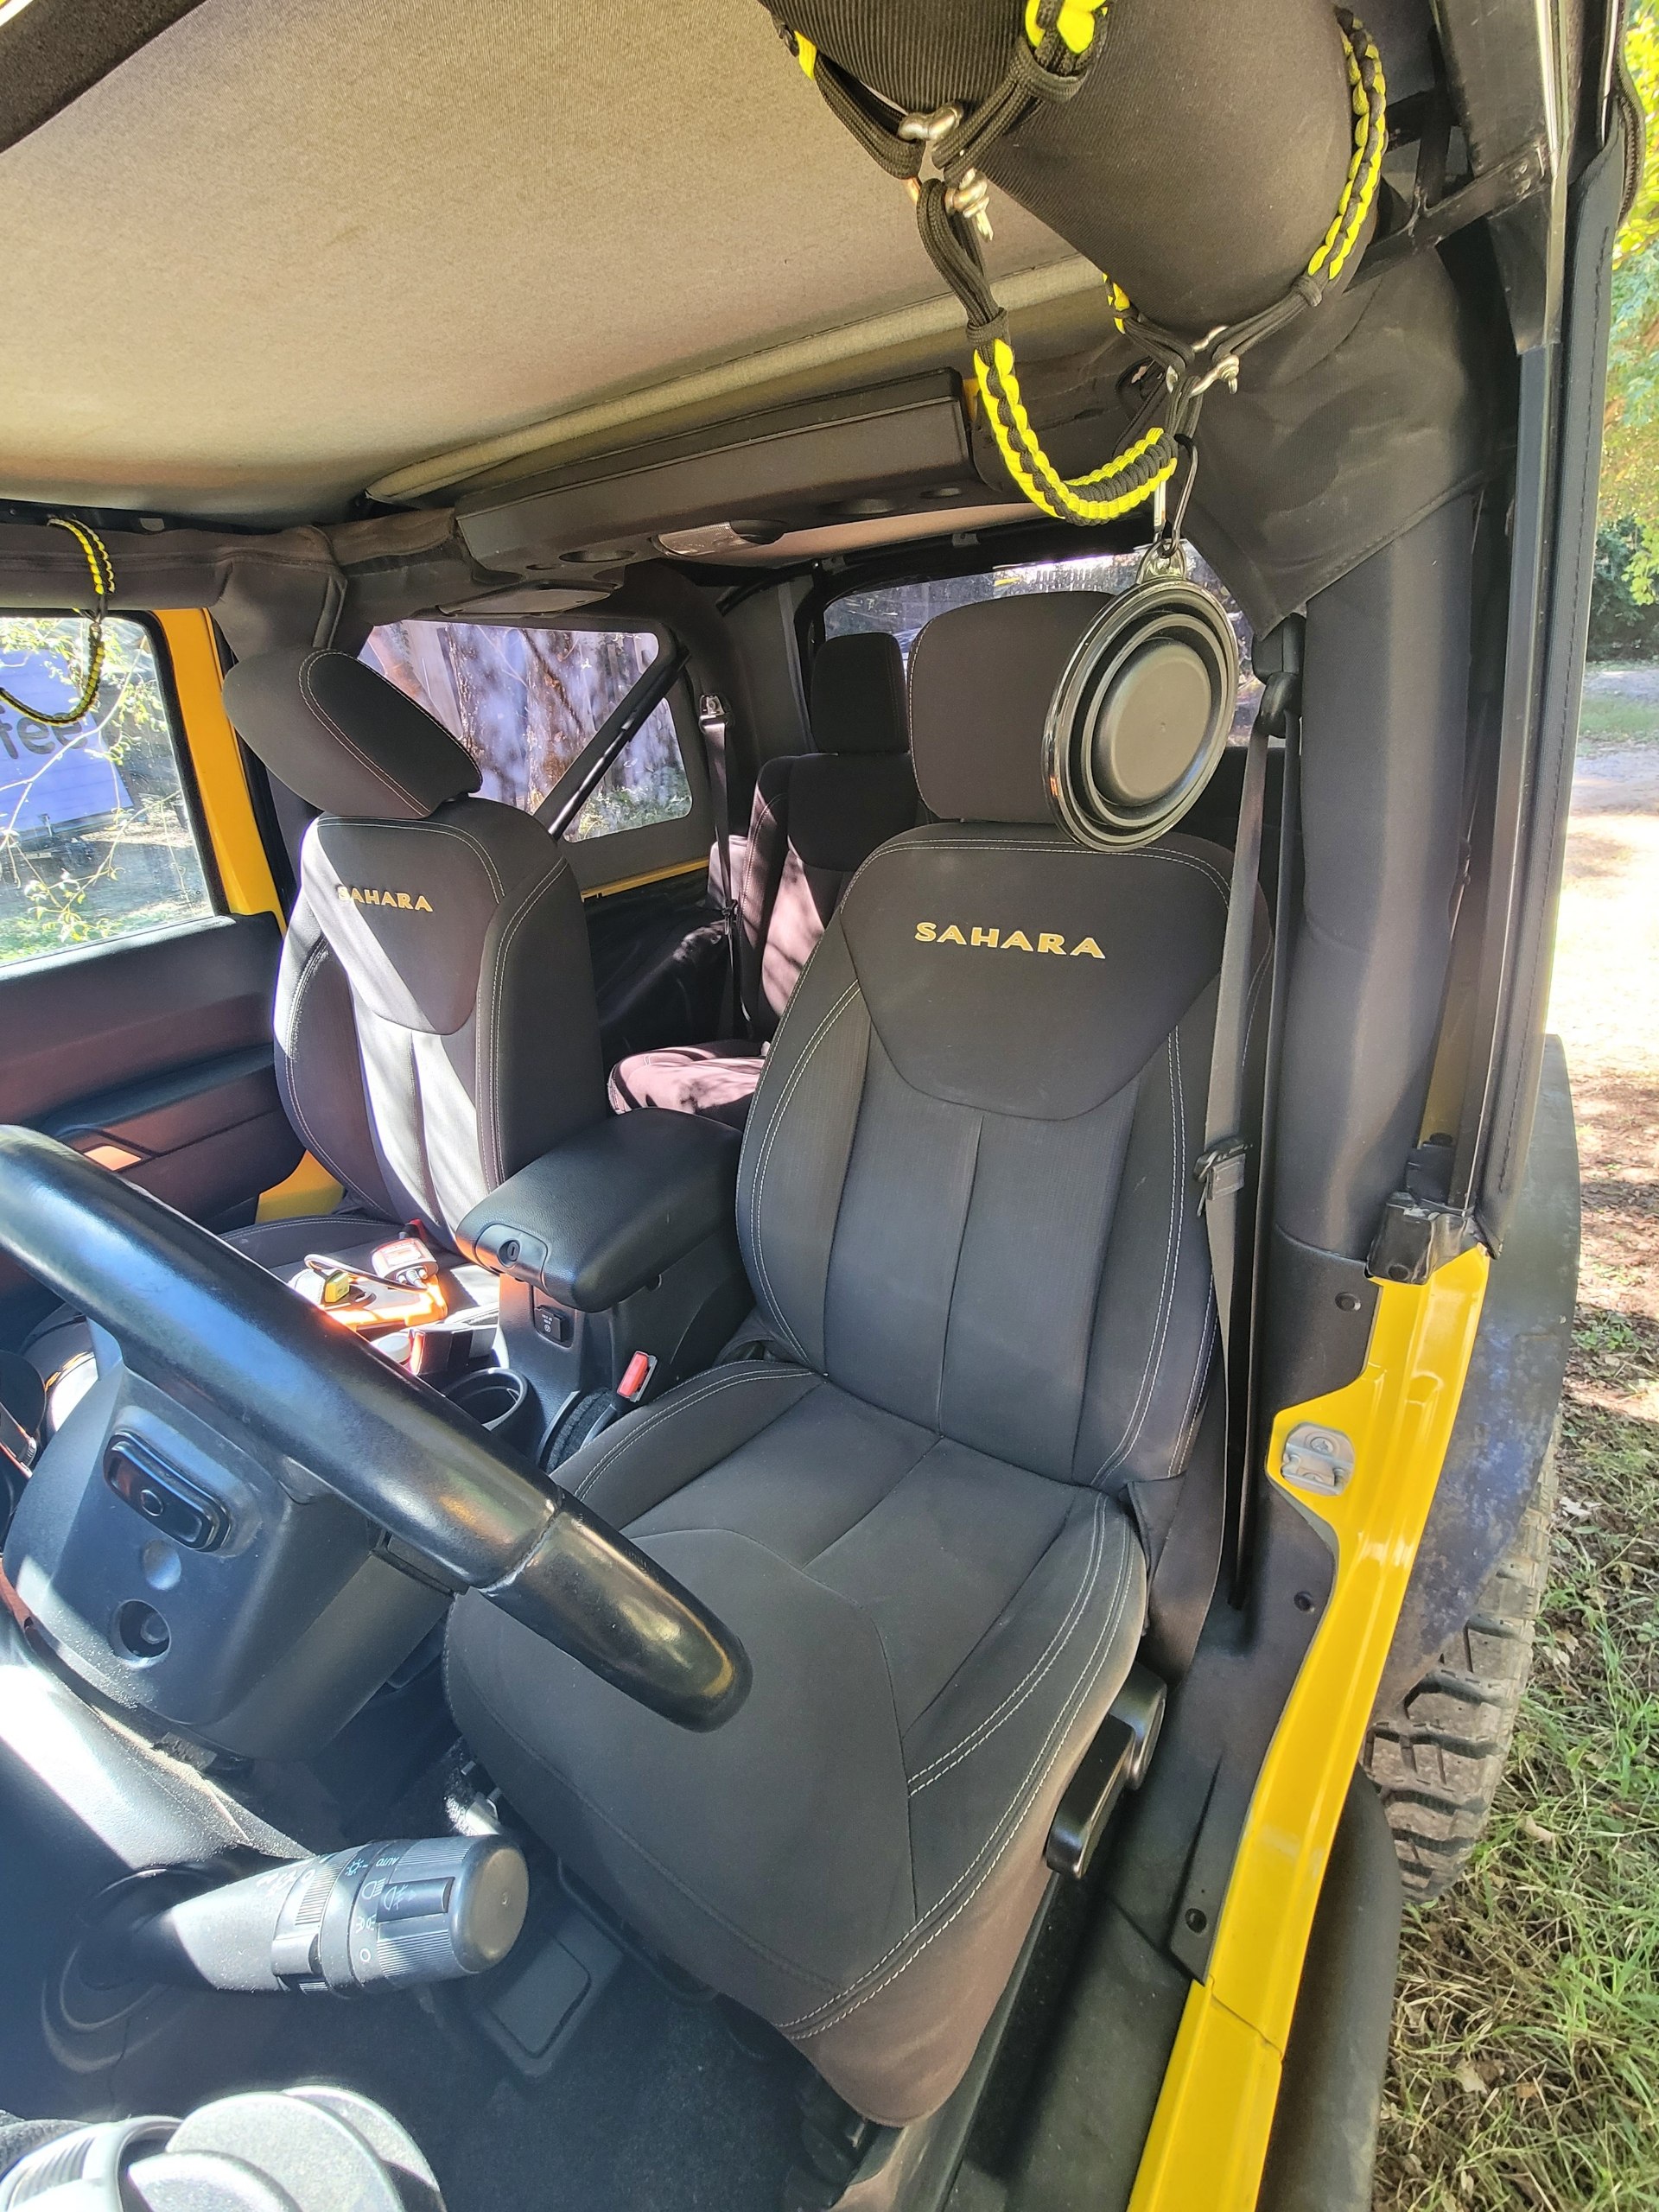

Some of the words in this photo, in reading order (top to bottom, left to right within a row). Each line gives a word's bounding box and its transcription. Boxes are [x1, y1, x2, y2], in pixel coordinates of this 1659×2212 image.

[337, 886, 434, 912] SAHARA
[914, 921, 1106, 959] SAHARA
[376, 1857, 400, 1867] AUTO
